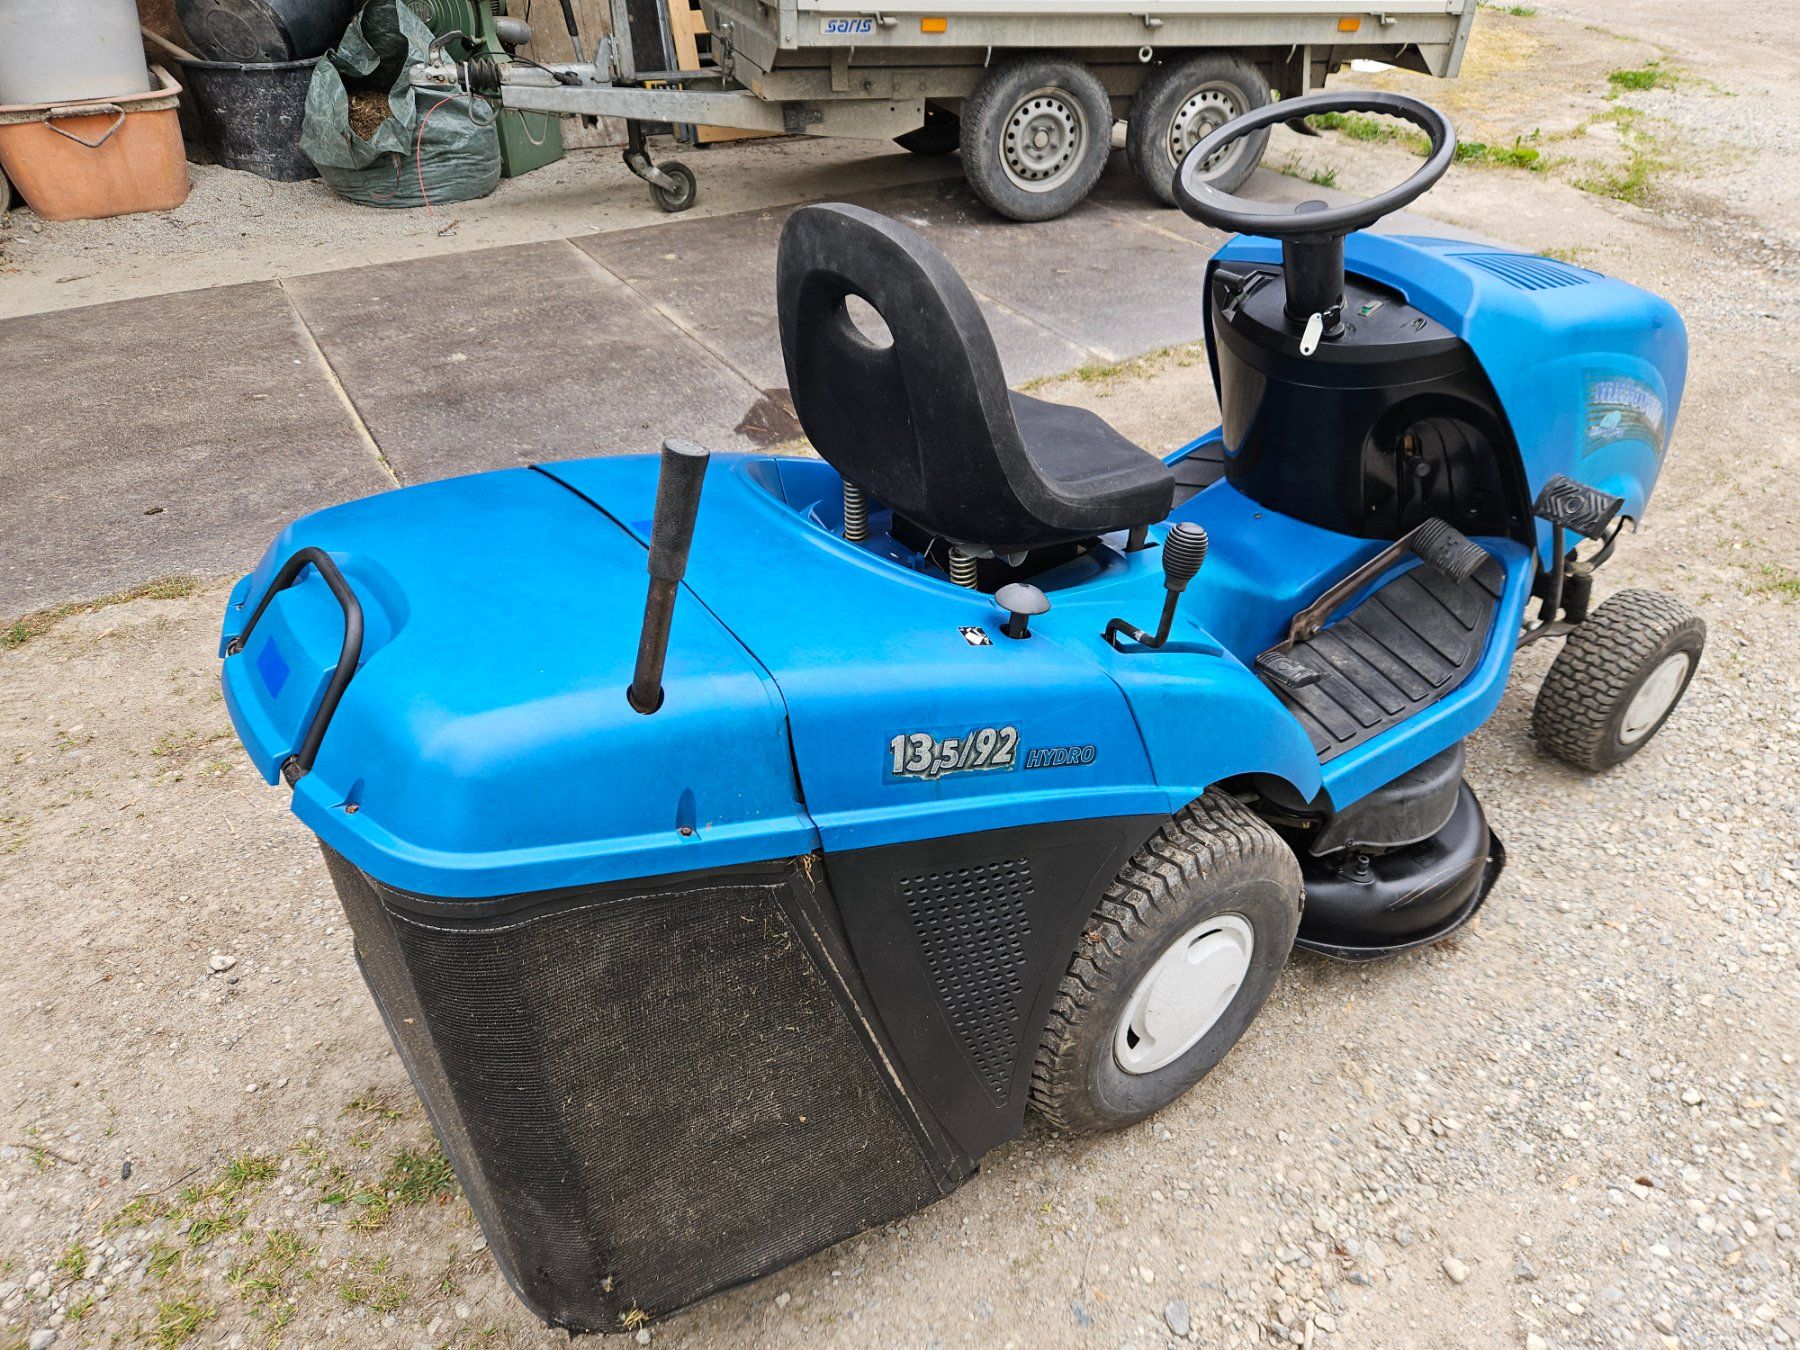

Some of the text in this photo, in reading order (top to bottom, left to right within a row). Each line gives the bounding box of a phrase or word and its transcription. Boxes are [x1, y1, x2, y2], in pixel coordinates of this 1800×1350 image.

[825, 19, 872, 32] saris
[890, 726, 1095, 775] 13,5/92 HYDRO
